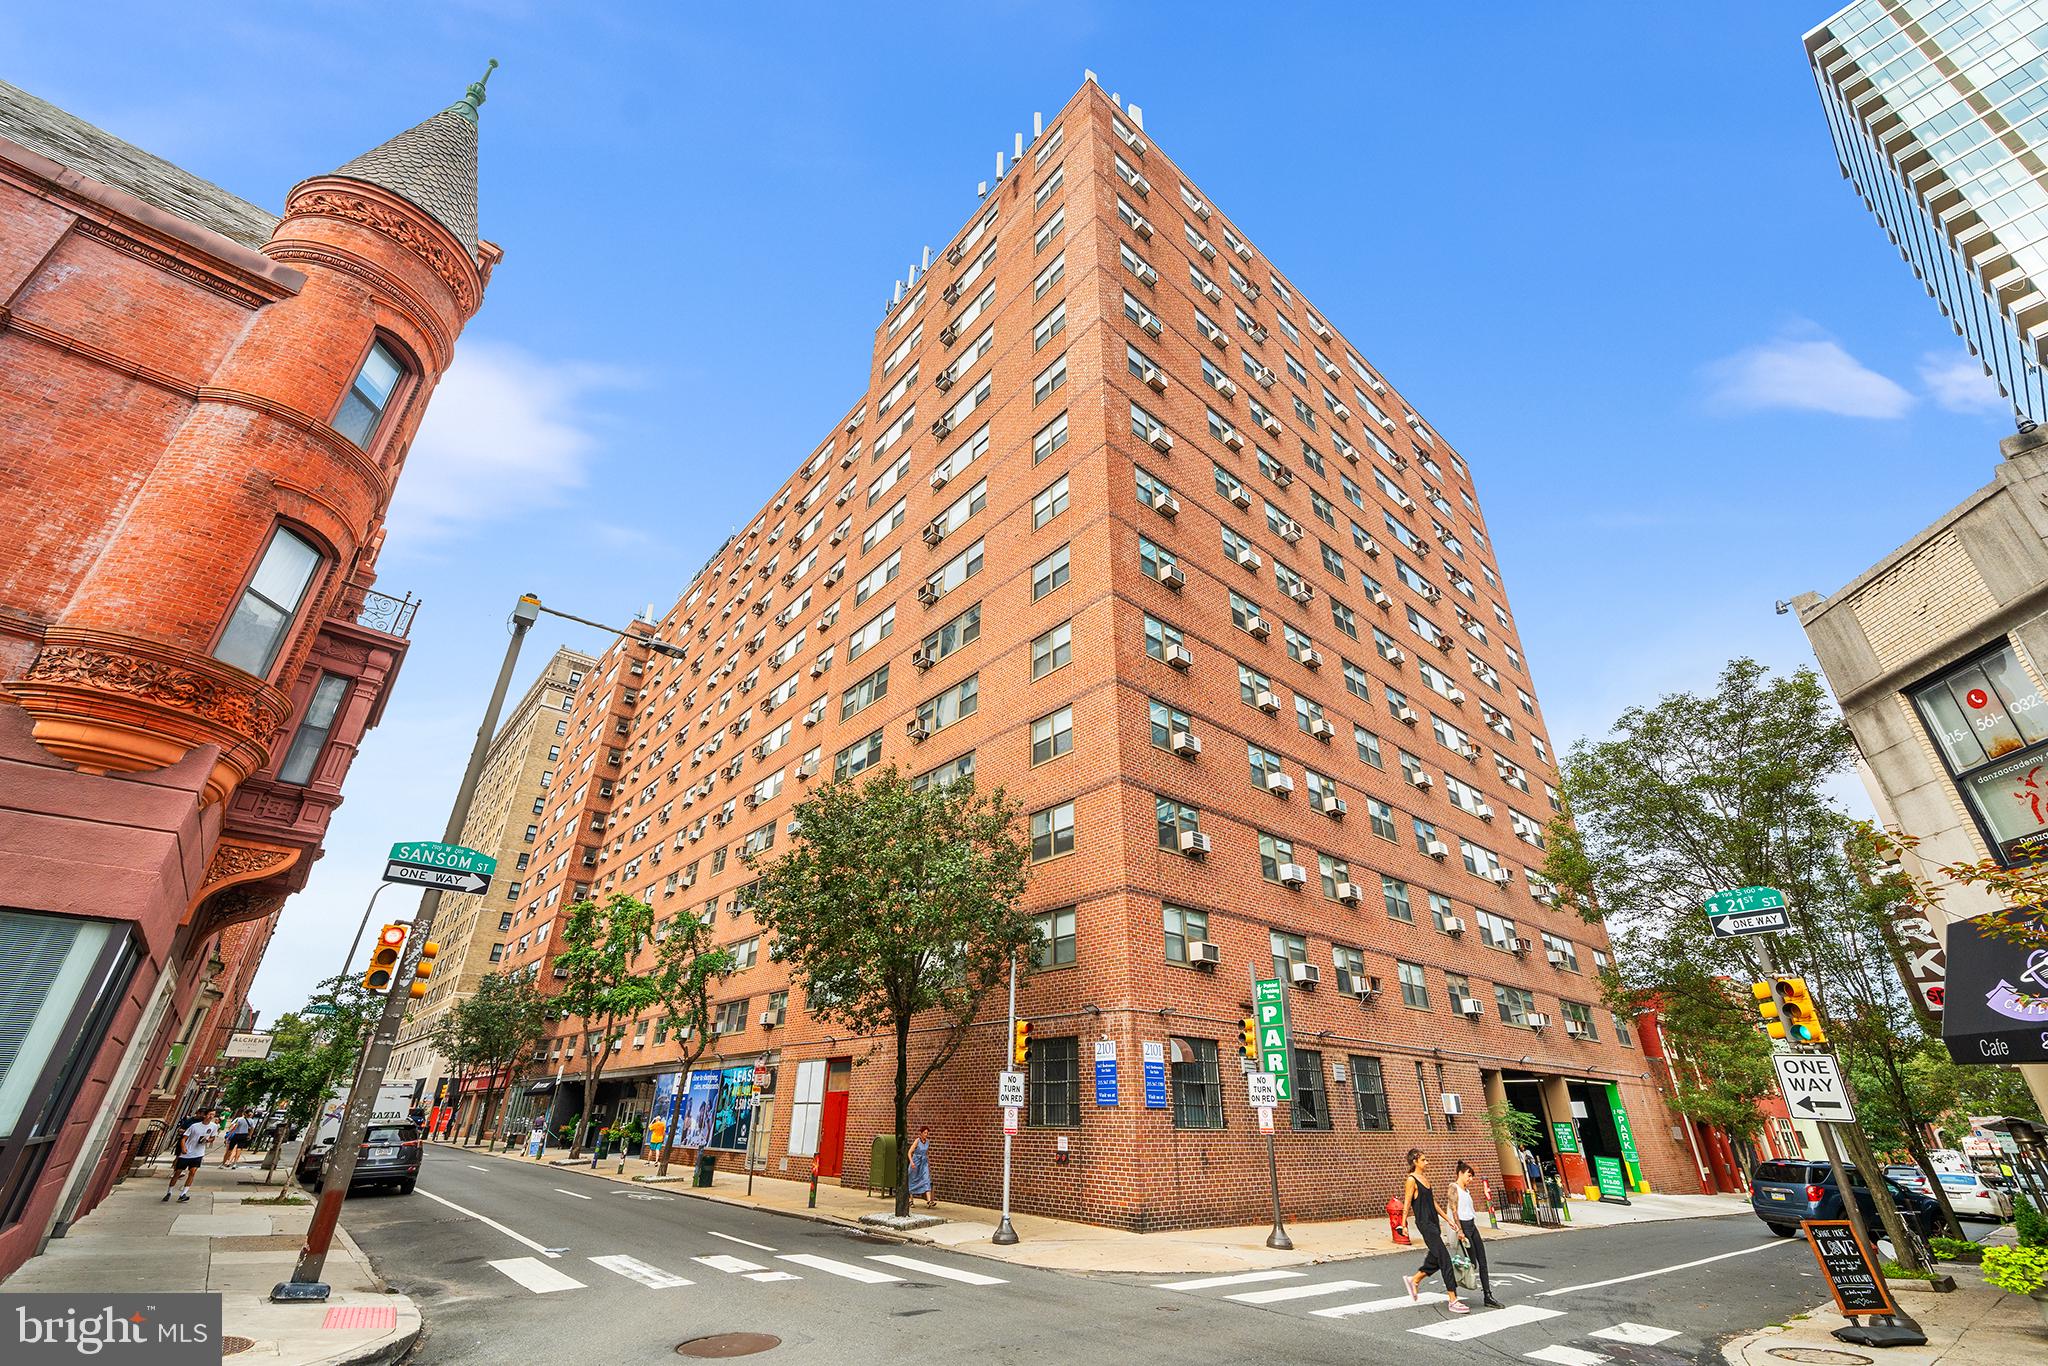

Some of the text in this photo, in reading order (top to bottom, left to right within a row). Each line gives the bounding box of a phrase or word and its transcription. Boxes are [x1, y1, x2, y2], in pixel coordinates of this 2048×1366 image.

[1976, 713, 2004, 732] 561-
[399, 846, 489, 872] SANSOM ST
[399, 868, 463, 885] ONE WAY
[1761, 896, 1777, 907] ST
[1732, 914, 1778, 928] ONE WAY
[1096, 1042, 1114, 1055] 2101
[1144, 1043, 1162, 1056] 2101
[1979, 1038, 2009, 1057] Cafe
[1783, 1060, 1830, 1075] ONE
[1007, 1075, 1017, 1083] NO
[1788, 1077, 1832, 1092] WAY
[1004, 1085, 1021, 1093] TURN
[1253, 1085, 1272, 1093] TURN
[1000, 1094, 1023, 1102] ON RED
[1617, 1115, 1632, 1150] PARK
[1816, 1239, 1860, 1256] LOVE
